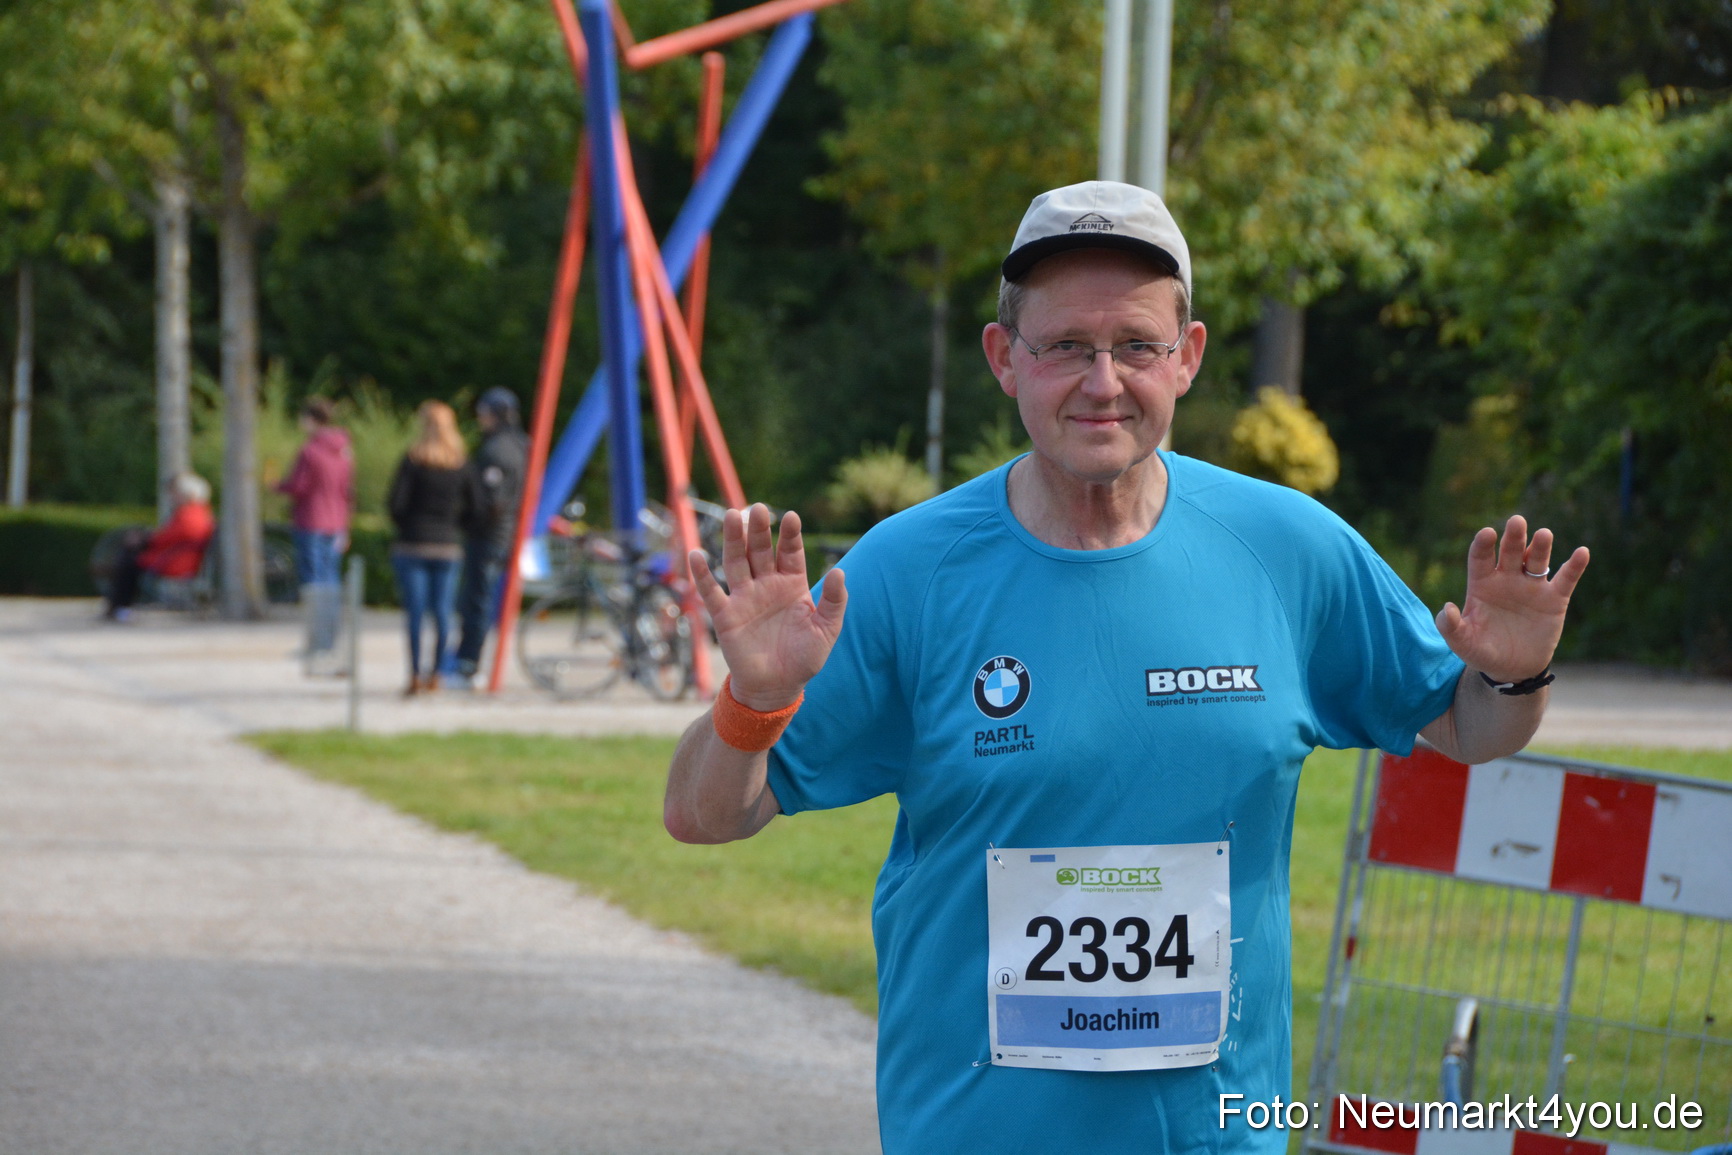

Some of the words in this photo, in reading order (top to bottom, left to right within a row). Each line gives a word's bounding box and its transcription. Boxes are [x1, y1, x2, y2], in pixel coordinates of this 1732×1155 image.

[977, 658, 1025, 682] BMW
[1145, 665, 1264, 696] BOCK
[1146, 697, 1185, 707] inspired
[1187, 696, 1199, 705] by
[1201, 695, 1228, 703] smart
[1230, 694, 1266, 703] concepts
[974, 724, 1034, 746] PARTL
[974, 740, 1035, 758] Neumarkt
[1080, 867, 1162, 886] BOCK
[1025, 914, 1195, 983] 2334
[1001, 973, 1010, 985] D
[1060, 1008, 1160, 1032] Joachim
